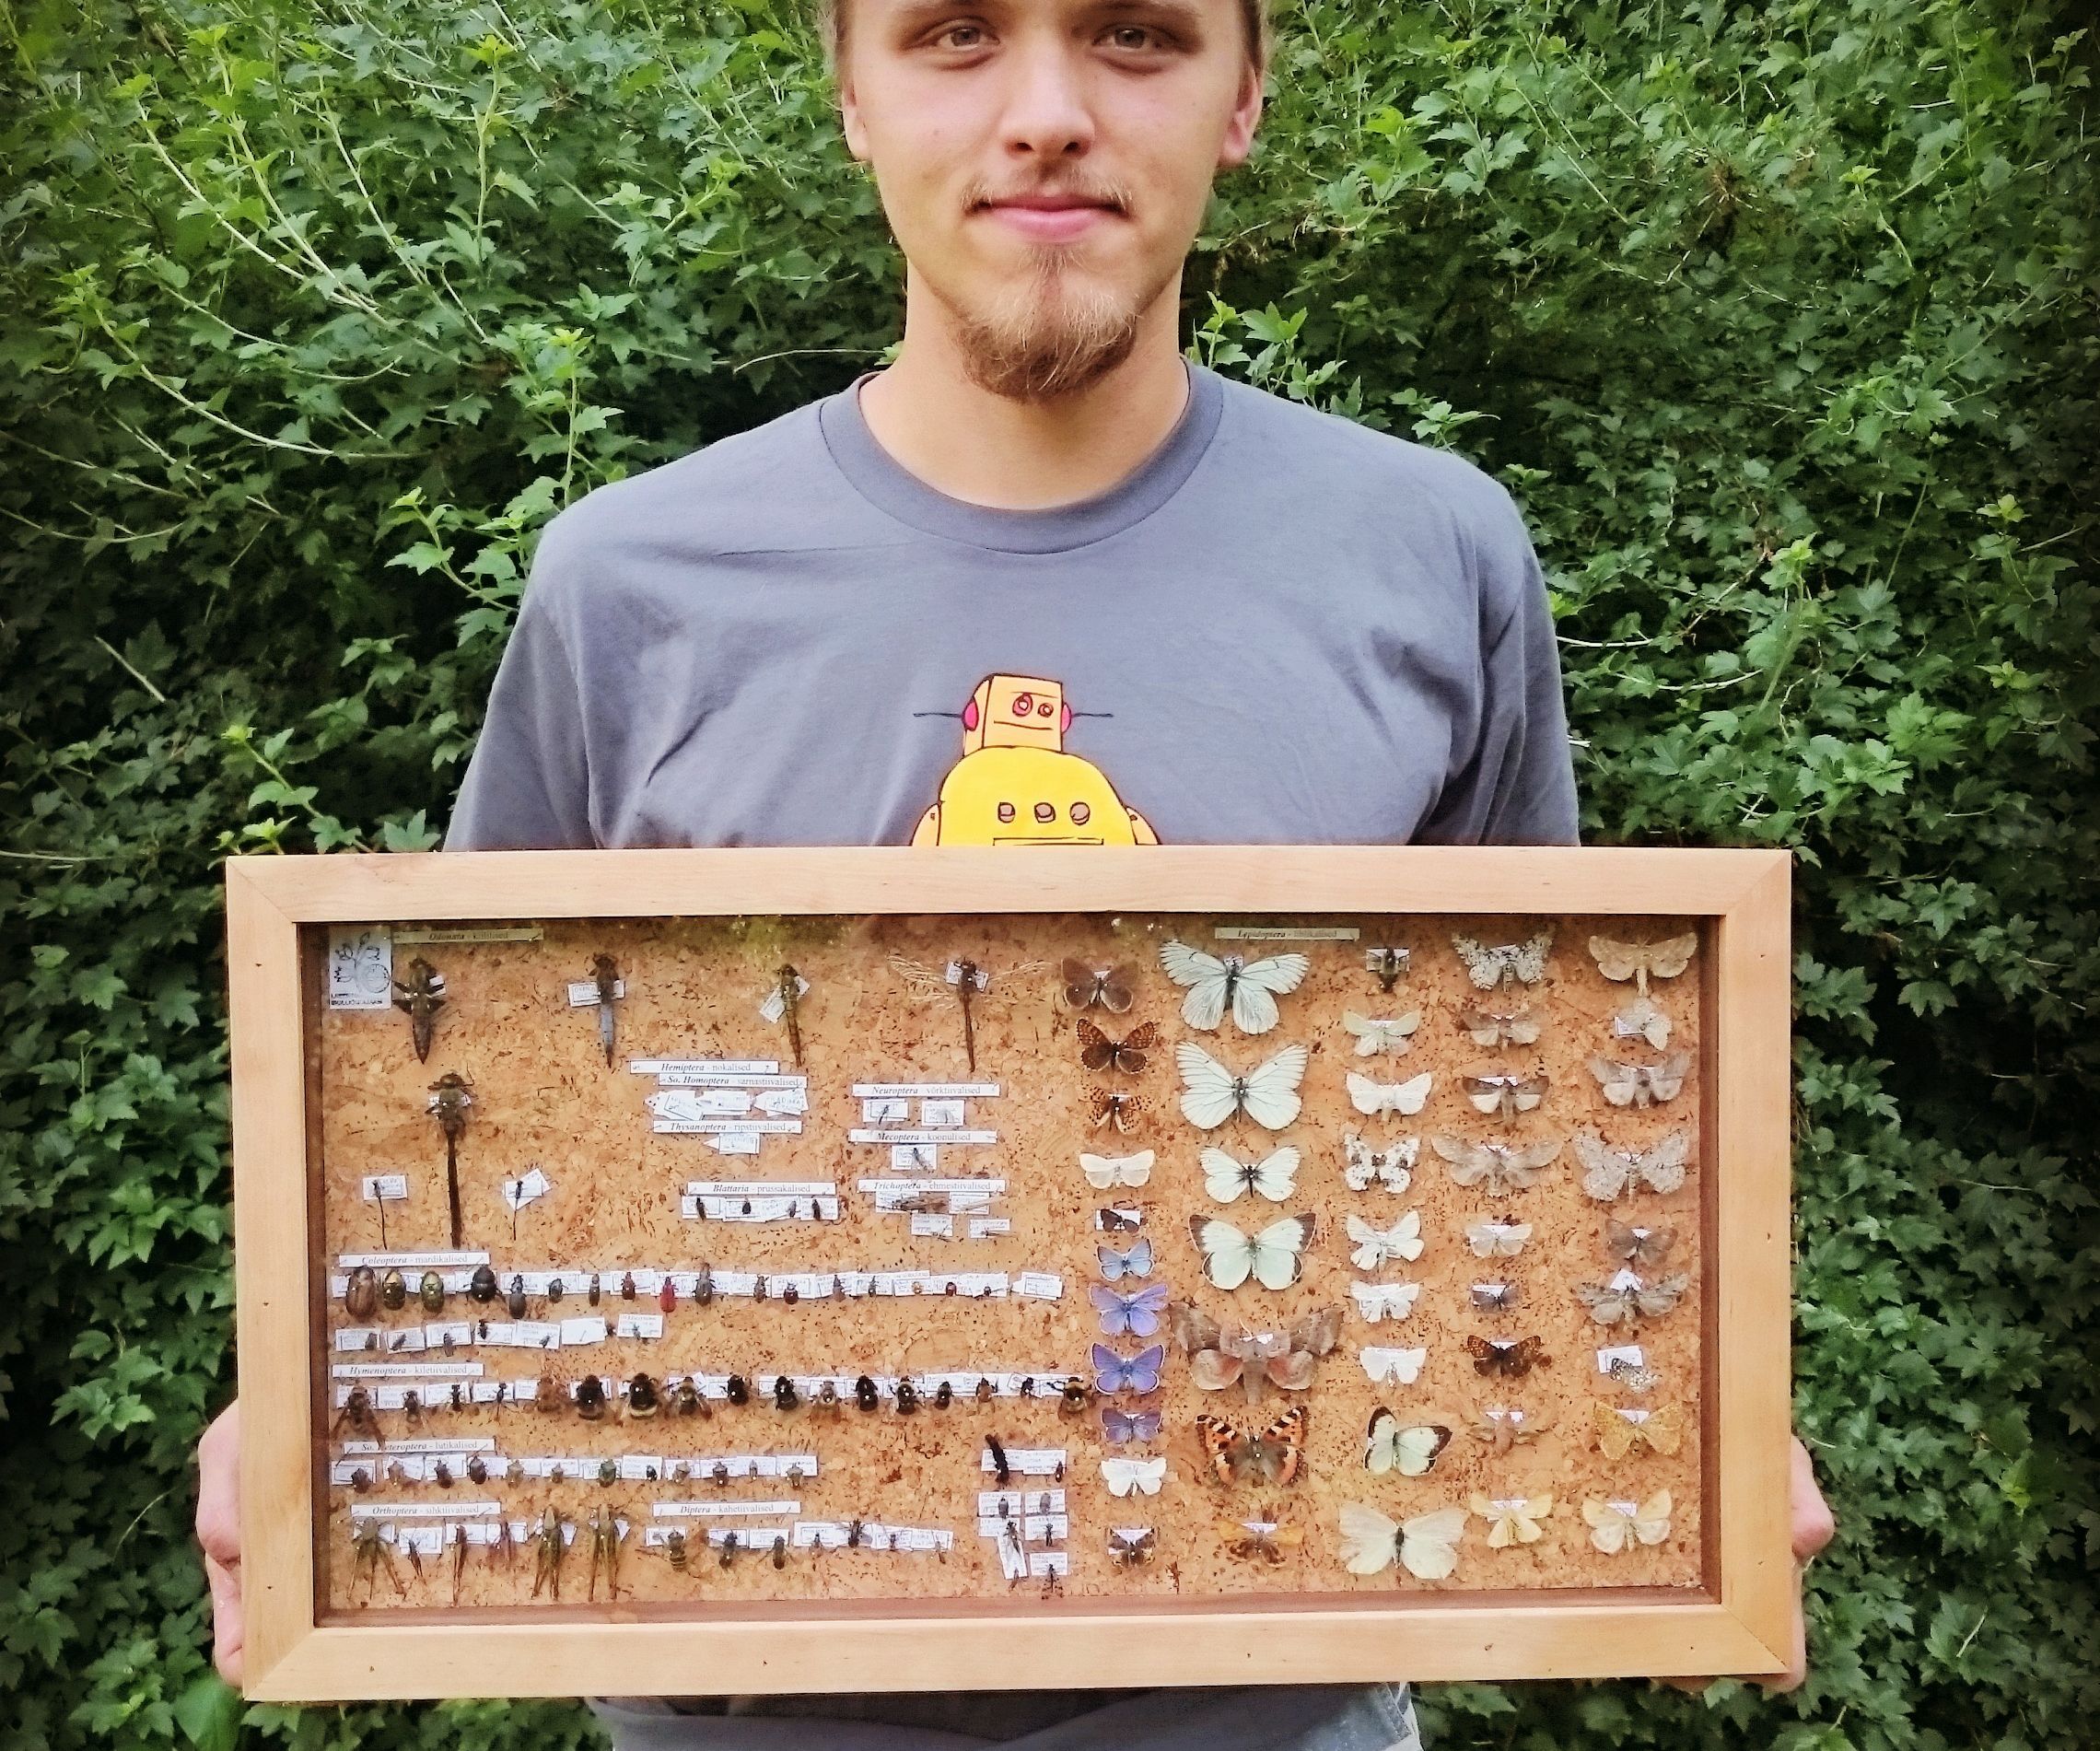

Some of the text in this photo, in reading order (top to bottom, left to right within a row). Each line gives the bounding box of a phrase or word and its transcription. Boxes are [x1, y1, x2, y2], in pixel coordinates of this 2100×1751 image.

[661, 1063, 705, 1073] Hemiptera
[712, 1063, 751, 1071] nokalised
[683, 1076, 729, 1087] Homoptera
[873, 1086, 918, 1097] Neuroptera
[671, 1122, 727, 1133] Thysanoptera
[877, 1133, 919, 1143] Mecoptera
[713, 1185, 749, 1193] Blattaria
[757, 1184, 811, 1195] prussakalised
[874, 1181, 921, 1192] Trichoptera
[362, 1256, 407, 1267] Coleoptera
[414, 1255, 468, 1264] mardikalised
[350, 1366, 406, 1377] Hymenoptera
[372, 1506, 417, 1516] Orthoptera
[680, 1505, 710, 1515] Diptera
